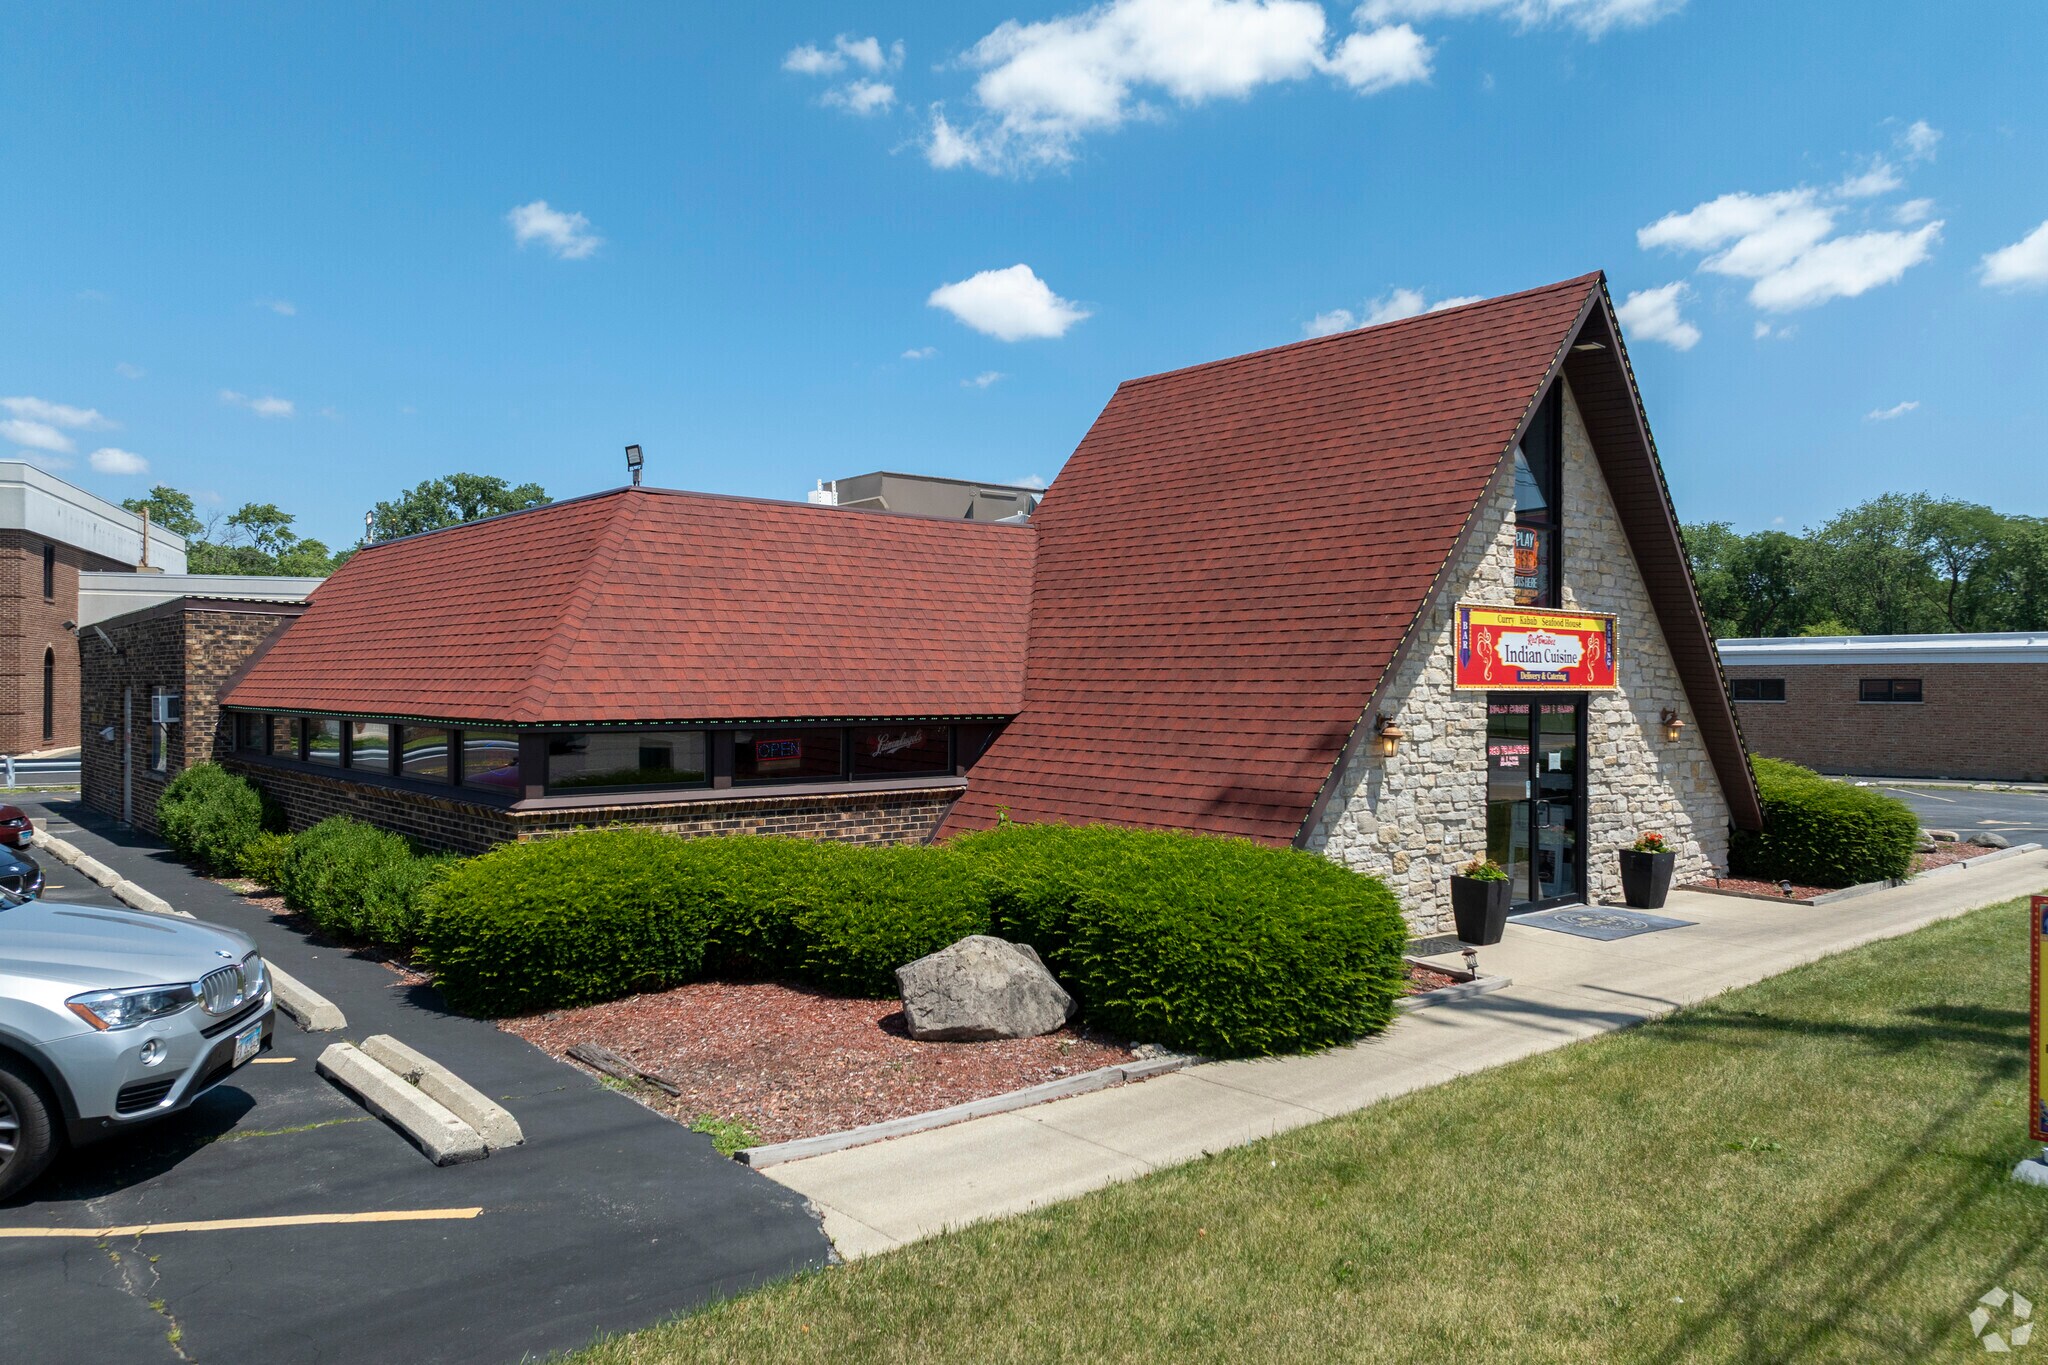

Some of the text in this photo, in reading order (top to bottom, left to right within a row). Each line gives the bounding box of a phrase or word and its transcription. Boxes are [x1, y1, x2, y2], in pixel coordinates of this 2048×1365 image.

[1516, 532, 1534, 547] PLAY
[1525, 577, 1537, 588] HERE
[1497, 615, 1581, 628] Curry Kabab Seafood House
[1505, 645, 1577, 664] Indian Cuisine
[1520, 671, 1567, 681] Delivery & Catering
[758, 742, 800, 758] OPEN
